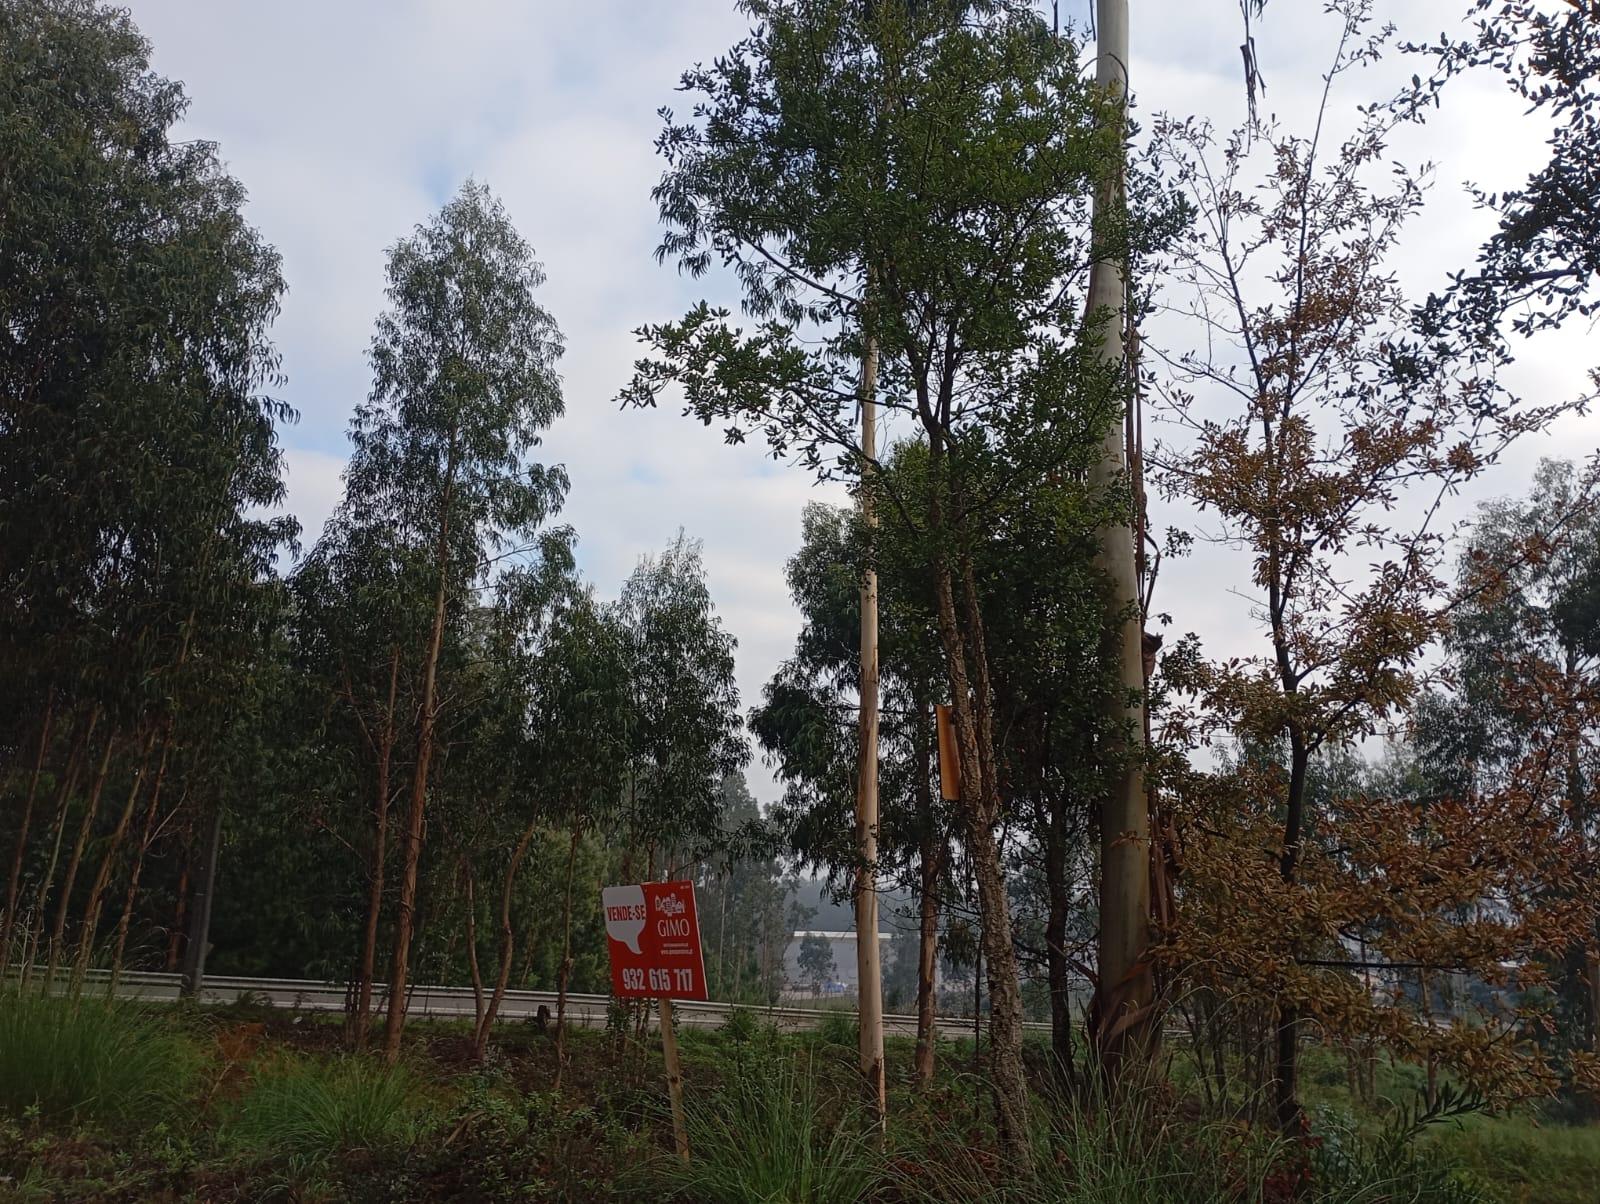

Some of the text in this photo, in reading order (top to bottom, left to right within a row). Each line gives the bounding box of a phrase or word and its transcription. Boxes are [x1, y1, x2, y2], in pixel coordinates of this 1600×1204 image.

[606, 904, 646, 922] VENDE-SE
[657, 919, 690, 937] GIMO
[622, 967, 693, 992] 932 615 717
